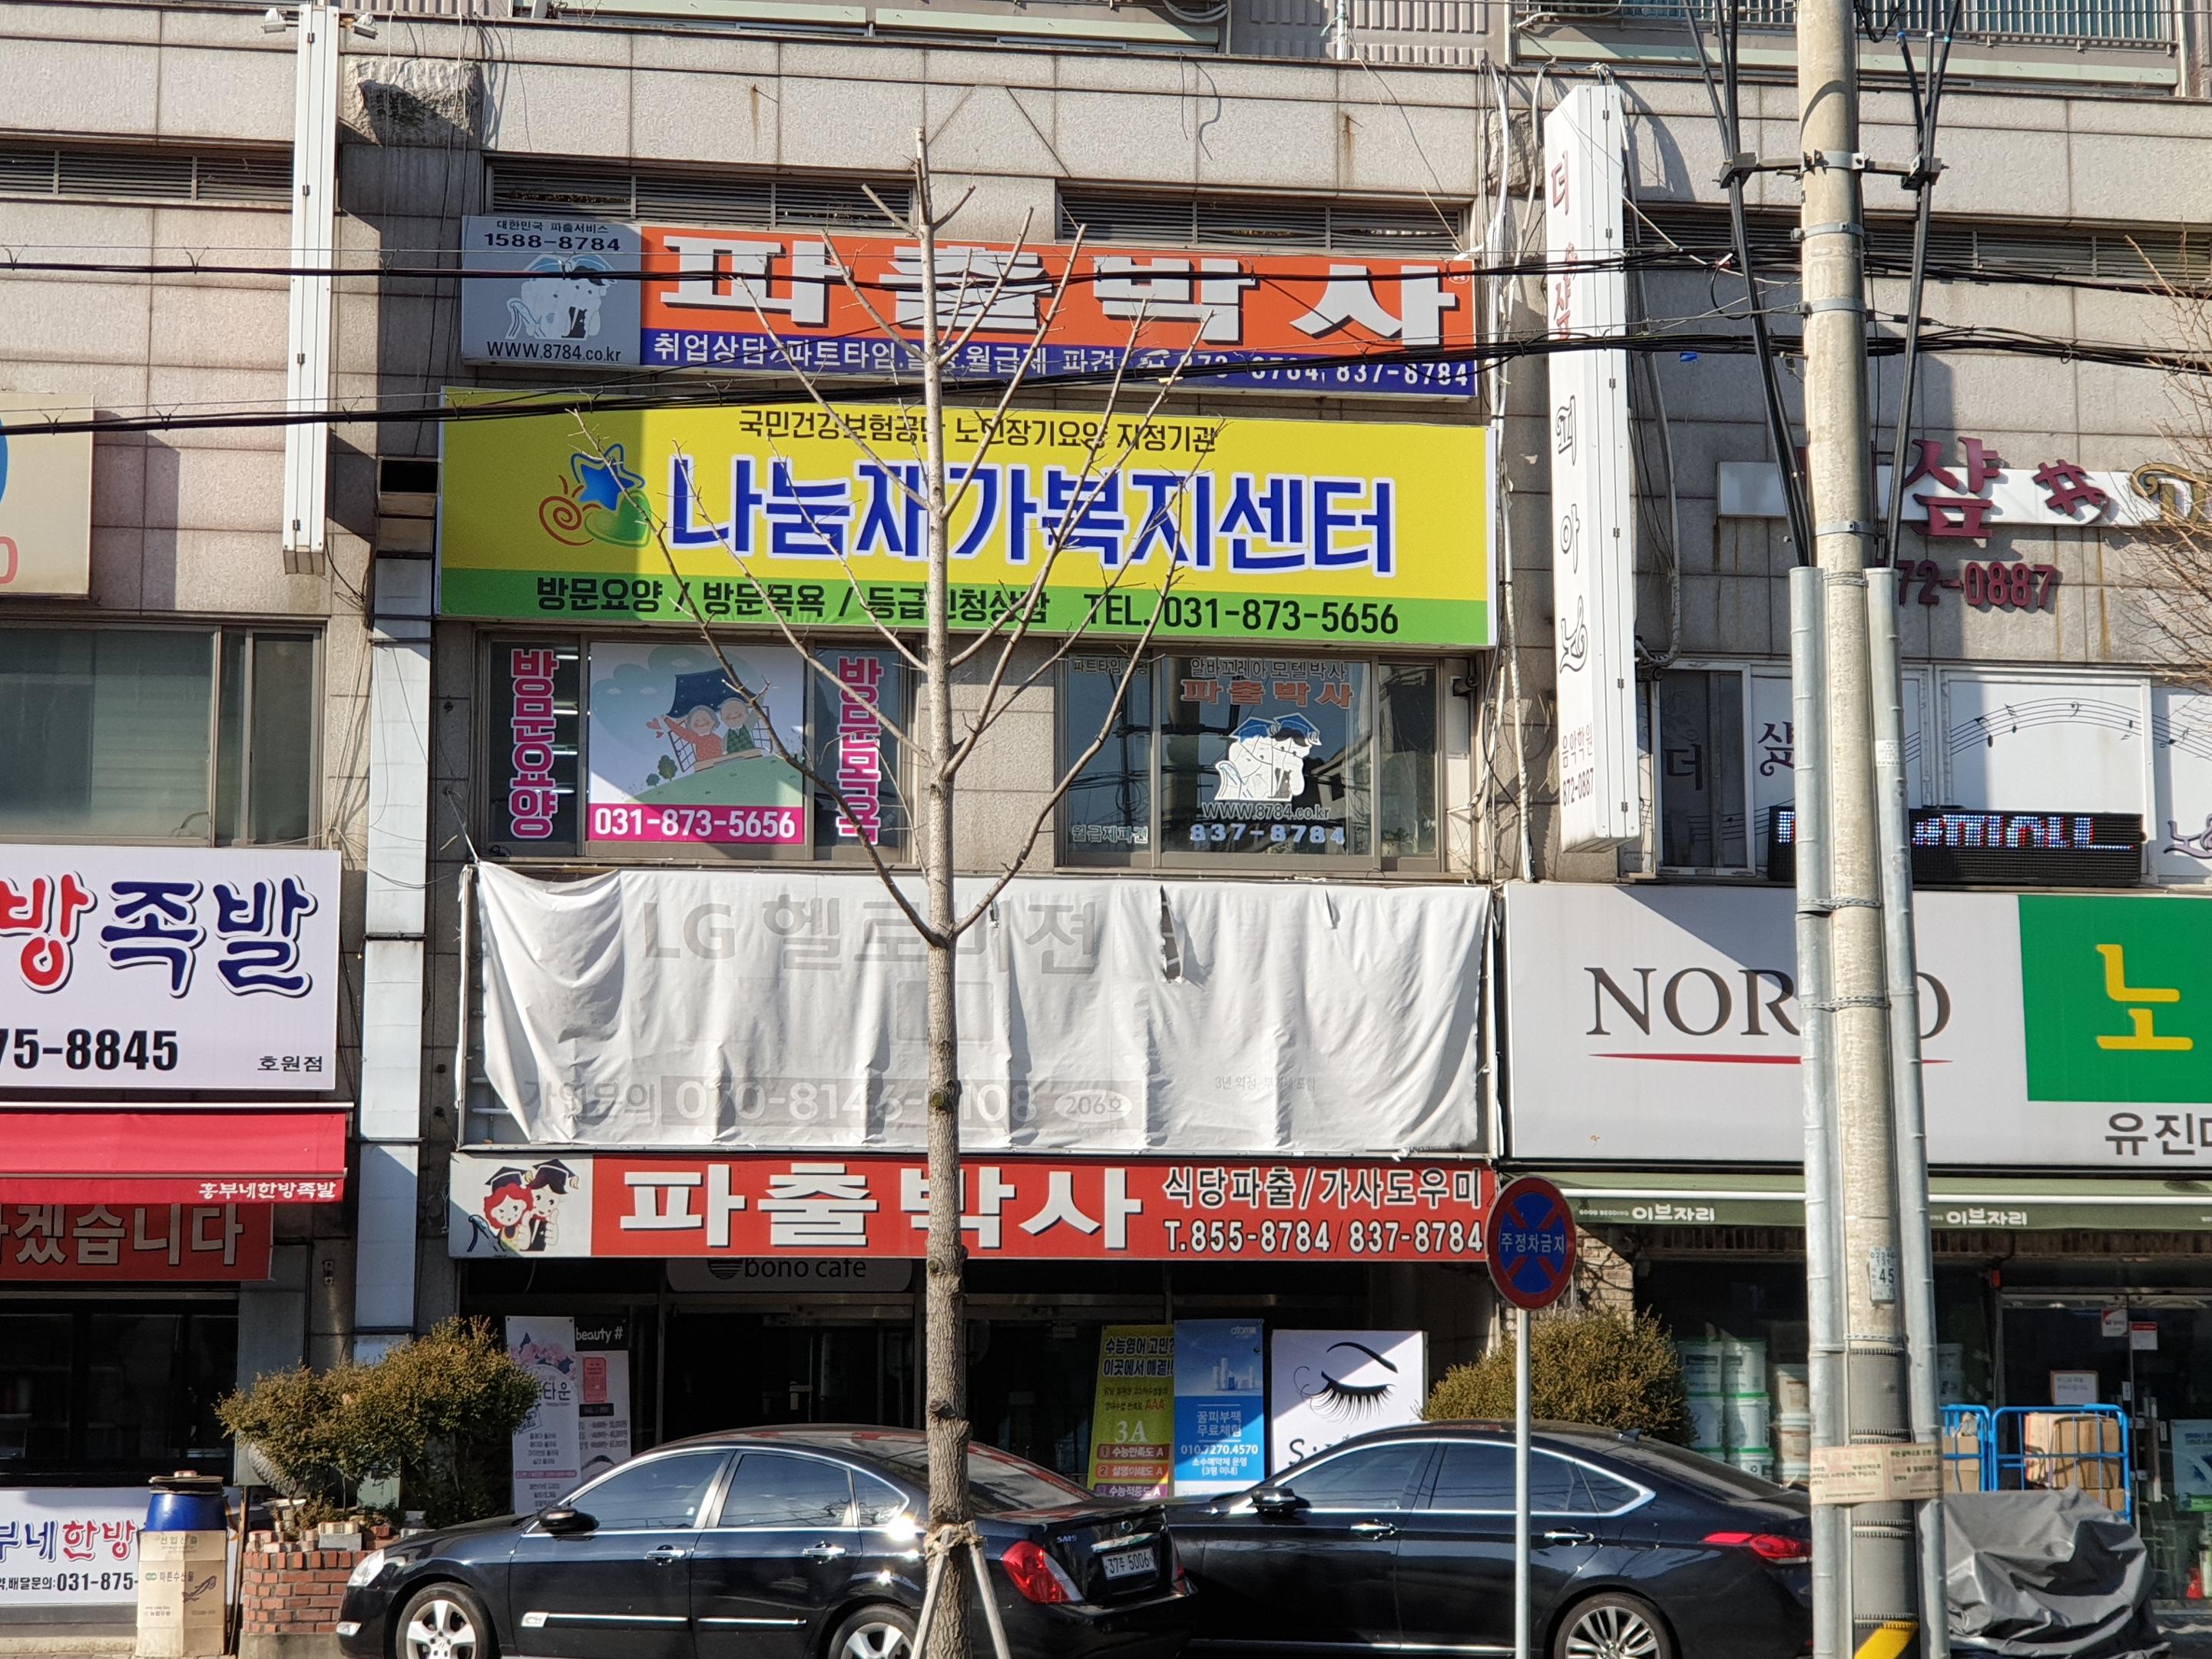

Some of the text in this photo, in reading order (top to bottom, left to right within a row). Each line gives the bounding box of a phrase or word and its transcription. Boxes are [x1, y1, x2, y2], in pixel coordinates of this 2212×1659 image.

[497, 220, 609, 233] 대한민국 파출서비스
[484, 233, 621, 251] 1588-8784
[660, 234, 1456, 347] 파출박사
[955, 419, 1108, 449] 노인장기요양
[1117, 423, 1217, 453] 지정기관
[1876, 558, 2055, 608] 72-0887
[537, 576, 663, 612] 방문요양
[704, 581, 825, 617] 방문목욕
[1163, 596, 1399, 636] 031-873-5656
[1073, 658, 1121, 675] 파트타임
[1181, 679, 1354, 709] 파출박사
[508, 648, 559, 839] 방문요양
[836, 657, 884, 845] 방문목욕
[1561, 722, 1593, 769] 음악학원
[1562, 767, 1594, 806] 872-0887
[594, 806, 796, 839] 031-873-5656
[1189, 822, 1346, 846] 837-8784
[644, 902, 735, 960] LG
[1584, 965, 1951, 1041] NOR
[2095, 944, 2194, 1051] 노
[257, 1055, 323, 1072] 호원점
[1215, 1075, 1231, 1089] 3년
[675, 1081, 1038, 1122] 00-8146-108
[1063, 1095, 1123, 1115] 206호
[198, 1181, 336, 1200] 흥부네한방족발
[619, 1162, 1142, 1250] 파출박사
[1632, 1204, 1715, 1221] 이브자리
[1946, 1207, 2028, 1226] 이브자리
[0, 1204, 243, 1266] 겠습니다
[1349, 1220, 1485, 1254] 837-8784
[1501, 1232, 1565, 1254] 주정차금지
[744, 1259, 866, 1278] bono cafe
[576, 1326, 612, 1343] beauty
[1105, 1337, 1146, 1356] 수능영어
[1104, 1358, 1144, 1376] 이곳에서
[1197, 1424, 1241, 1438] 무료체험
[1181, 1444, 1259, 1455] 010.7270.4570
